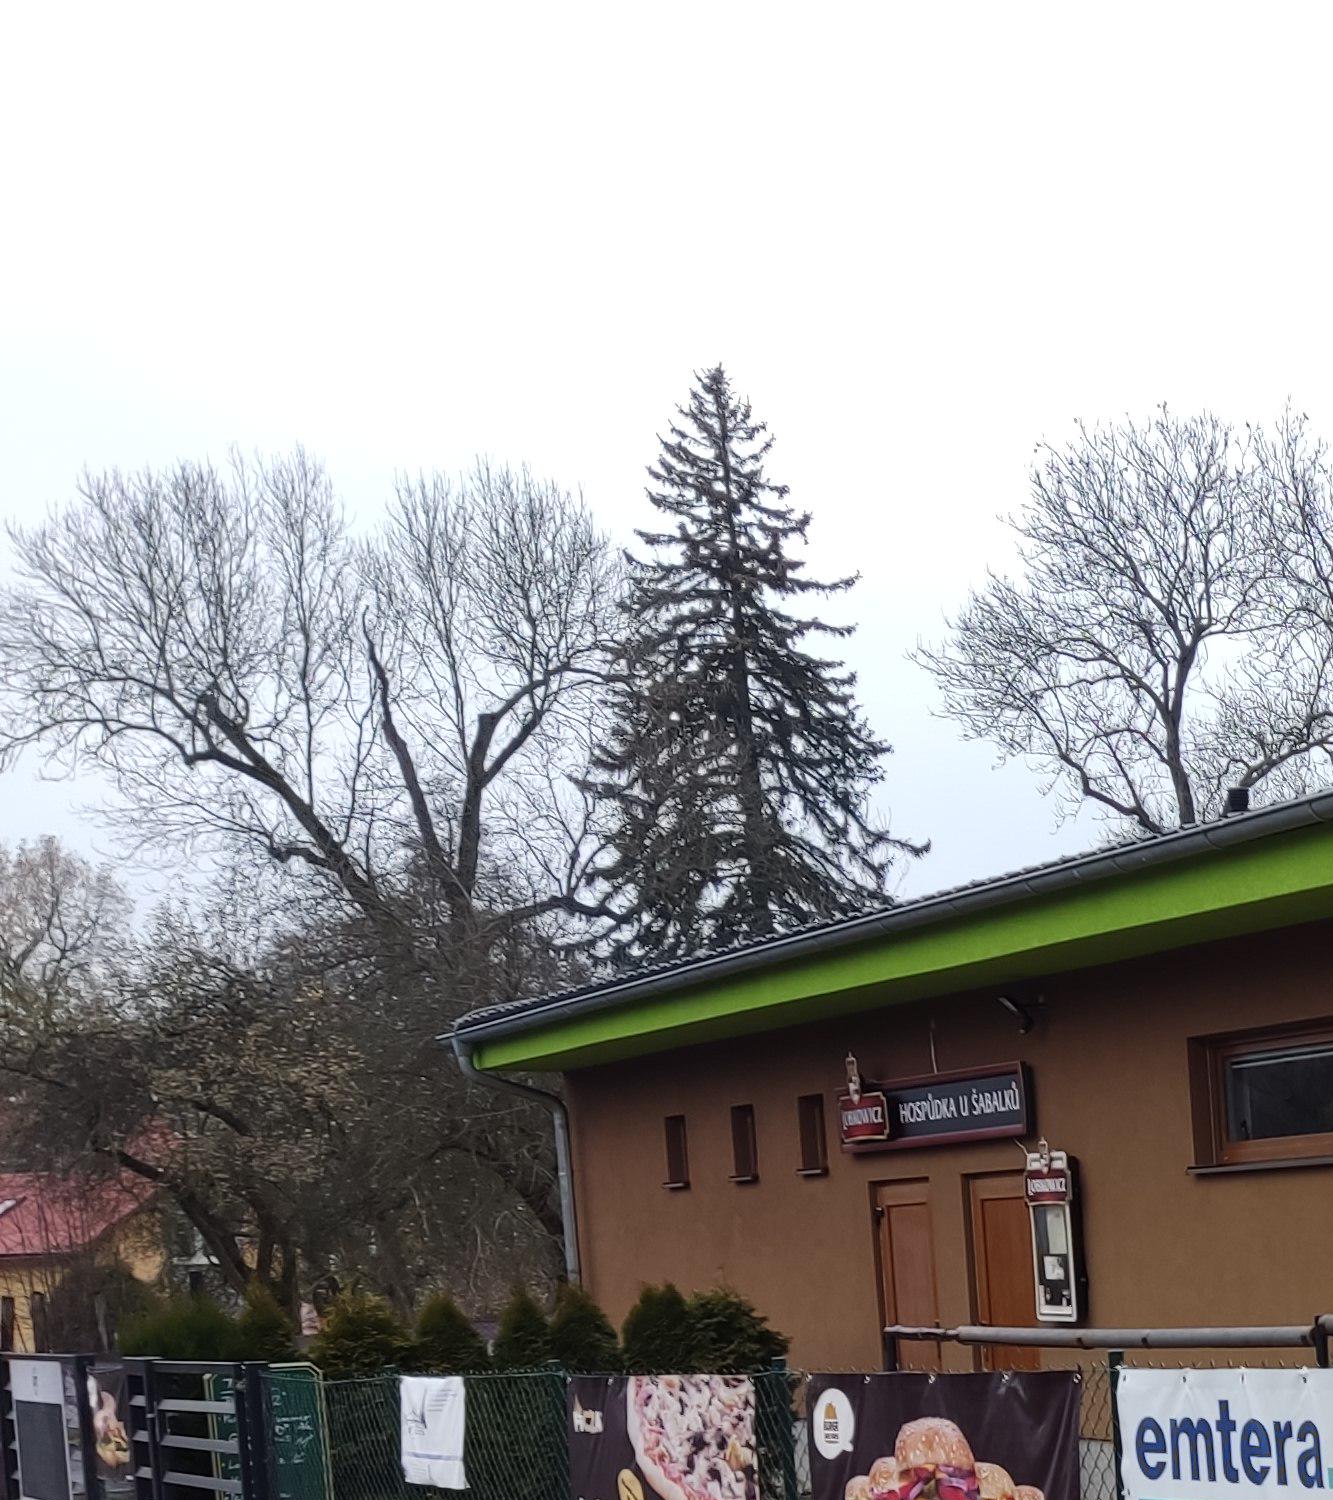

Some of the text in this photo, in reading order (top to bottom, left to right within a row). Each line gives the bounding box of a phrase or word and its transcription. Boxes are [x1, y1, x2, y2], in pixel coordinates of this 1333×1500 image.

[899, 1081, 1020, 1124] HOSPŮDKA U ŠABALKŮ
